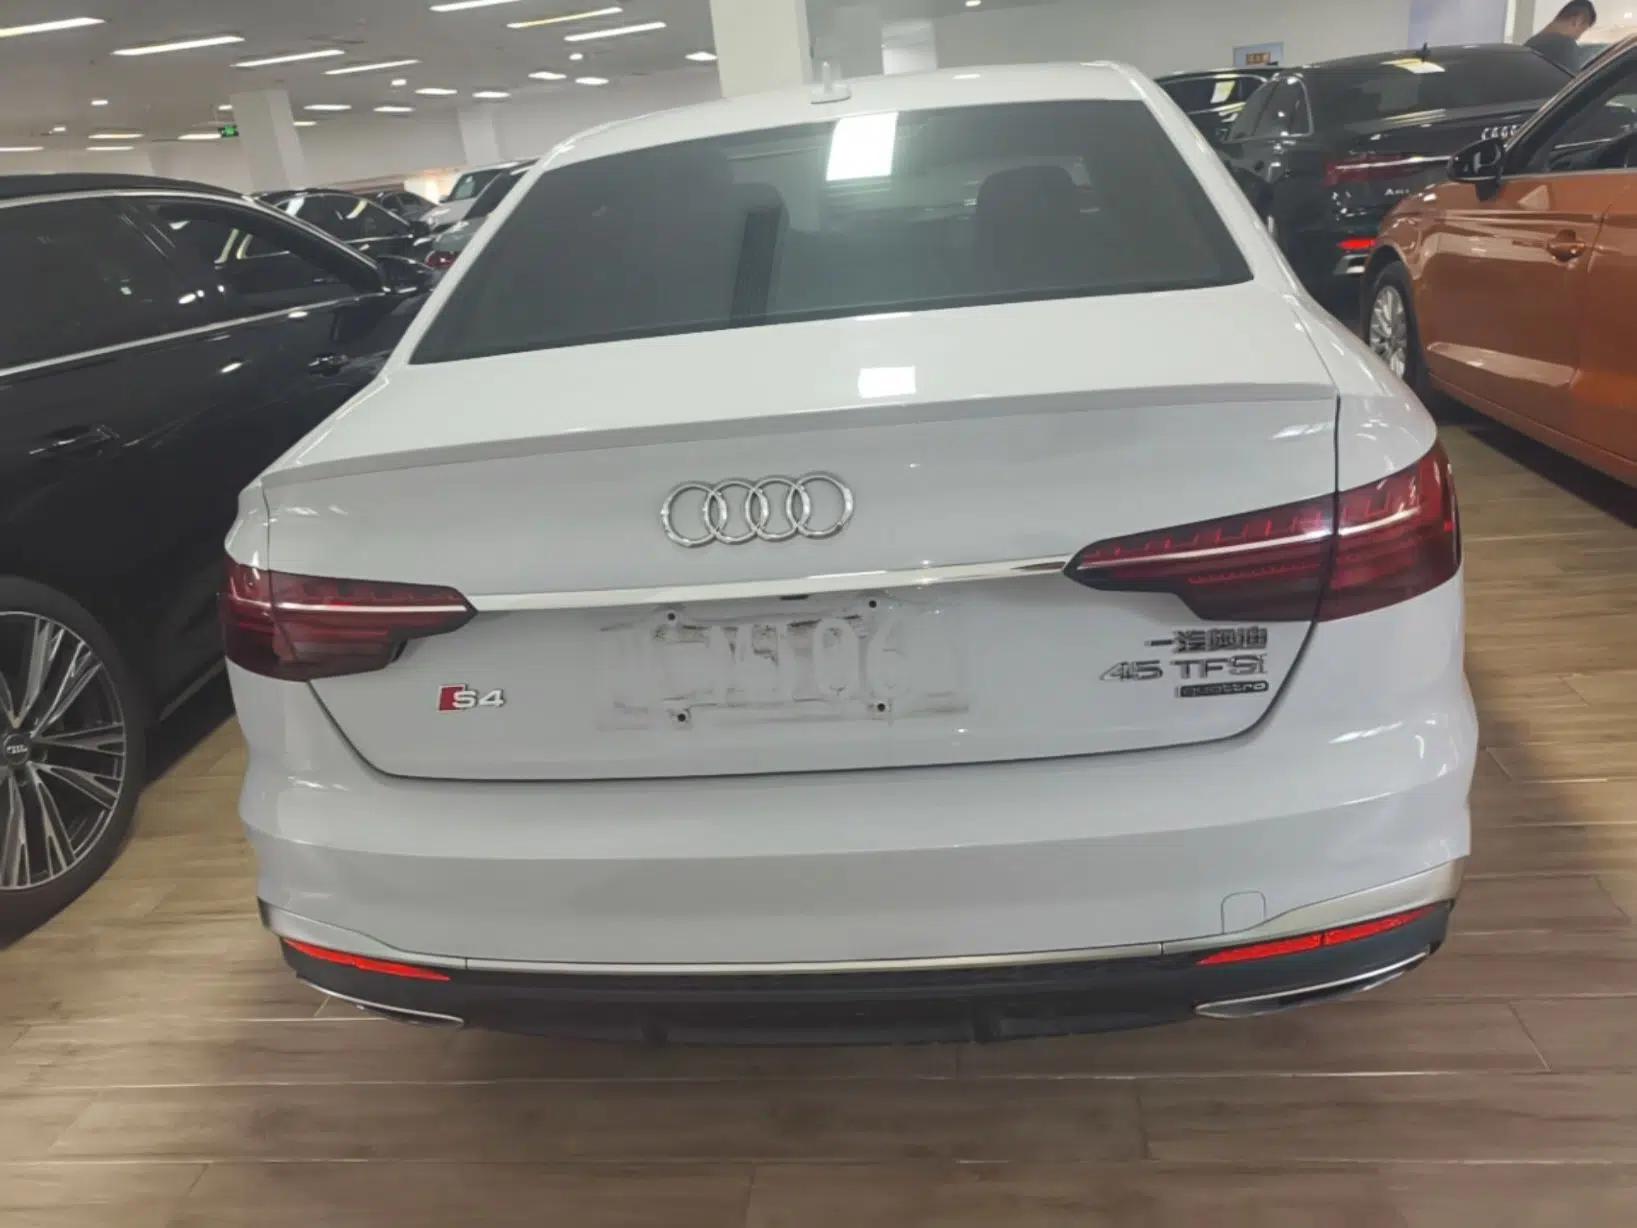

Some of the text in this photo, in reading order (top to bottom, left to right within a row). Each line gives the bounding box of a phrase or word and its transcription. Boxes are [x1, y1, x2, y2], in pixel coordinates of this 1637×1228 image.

[1144, 627, 1268, 653] 一汽奥迪
[1100, 659, 1164, 681] 45
[449, 687, 505, 708] S4
